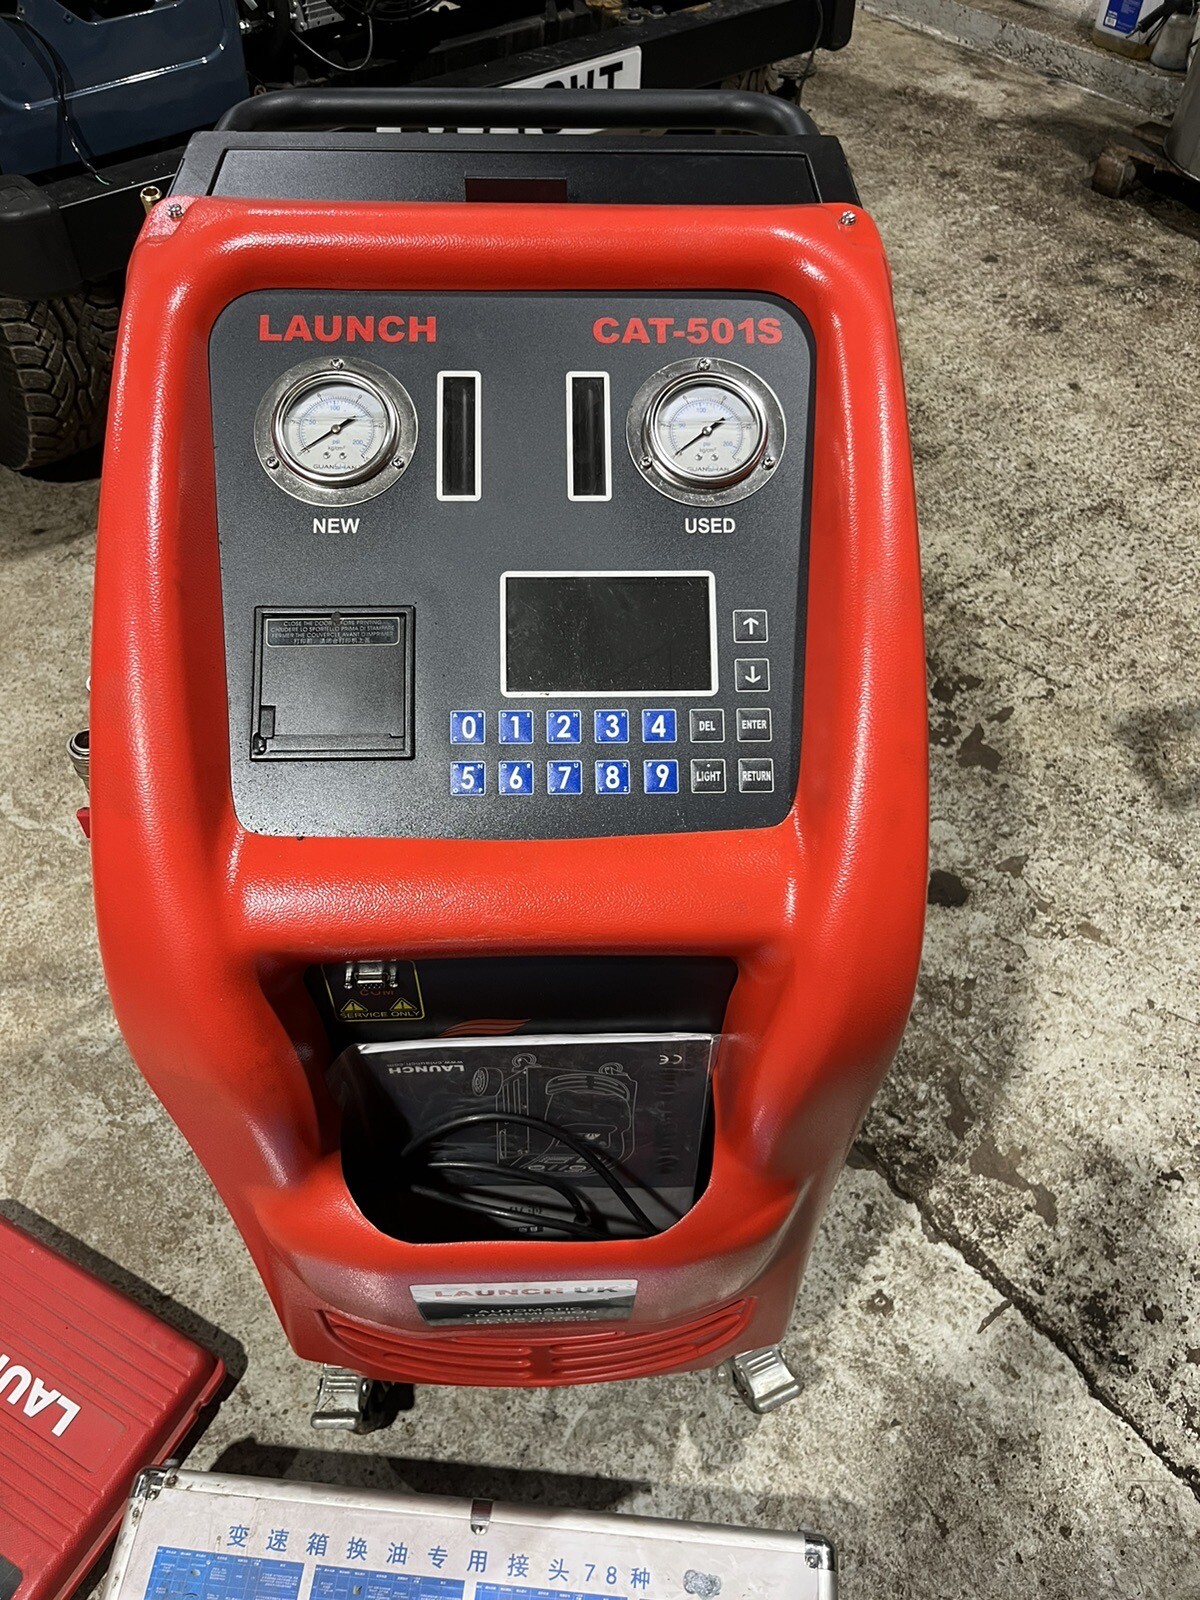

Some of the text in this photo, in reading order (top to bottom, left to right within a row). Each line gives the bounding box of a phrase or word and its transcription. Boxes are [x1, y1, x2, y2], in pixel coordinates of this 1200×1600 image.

[259, 315, 437, 342] LAUNCH
[592, 317, 783, 344] CAT-501S
[313, 518, 360, 533] NEW
[685, 518, 736, 533] USED
[462, 716, 476, 739] 0
[510, 716, 519, 738] 1
[557, 715, 571, 738] 2
[605, 714, 620, 738] 3
[651, 715, 666, 738] 4
[699, 721, 716, 731] DEL
[742, 720, 767, 729] ENTER
[461, 766, 475, 789] 5
[509, 766, 523, 789] 6
[558, 766, 572, 789] 7
[605, 765, 620, 789] 8
[656, 764, 669, 788] 9
[696, 771, 721, 781] LIGHT
[742, 771, 771, 781] RETURN
[388, 1064, 465, 1074] LAUNCH
[434, 1286, 619, 1298] LAUNCH UK
[0, 1353, 82, 1437] LAU
[226, 1524, 650, 1589] 变速箱换油专用接头78种
